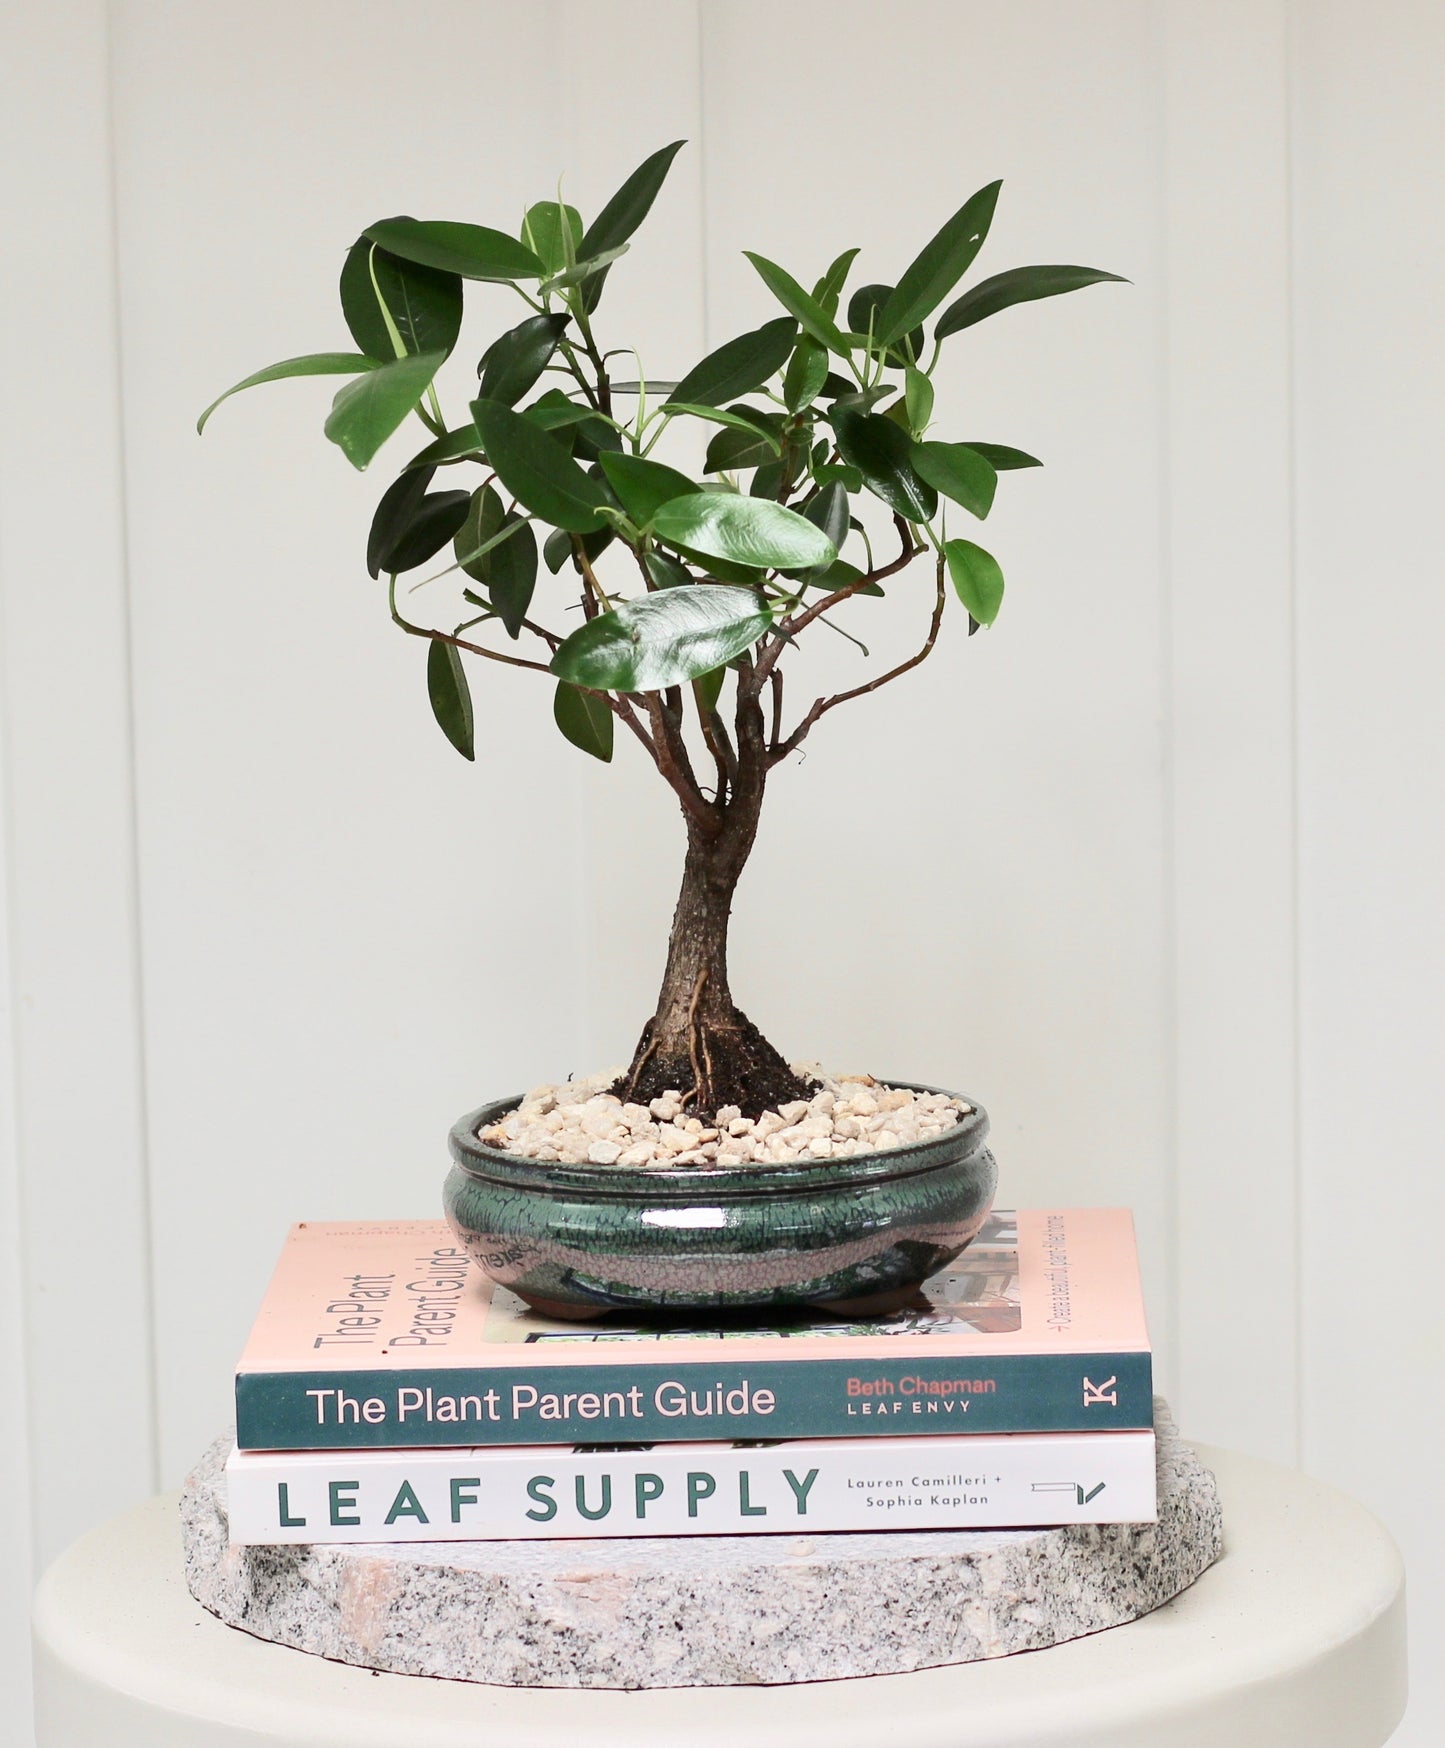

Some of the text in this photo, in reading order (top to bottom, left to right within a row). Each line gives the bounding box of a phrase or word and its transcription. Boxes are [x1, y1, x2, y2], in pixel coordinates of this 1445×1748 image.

[405, 1247, 472, 1293] Guide
[326, 1274, 396, 1314] Plant
[388, 1295, 461, 1347] Parent
[1046, 1302, 1072, 1325] Create
[313, 1316, 382, 1349] The
[305, 1380, 776, 1424] The Plant Parent Guide
[846, 1376, 996, 1396] Beth Chapman
[847, 1400, 970, 1415] LEAF ENVY
[278, 1468, 820, 1528] LEAF SUPPLY
[847, 1477, 903, 1489] Lauren
[911, 1475, 987, 1487] Camilleri
[866, 1494, 988, 1508] Sophia Kaplan
